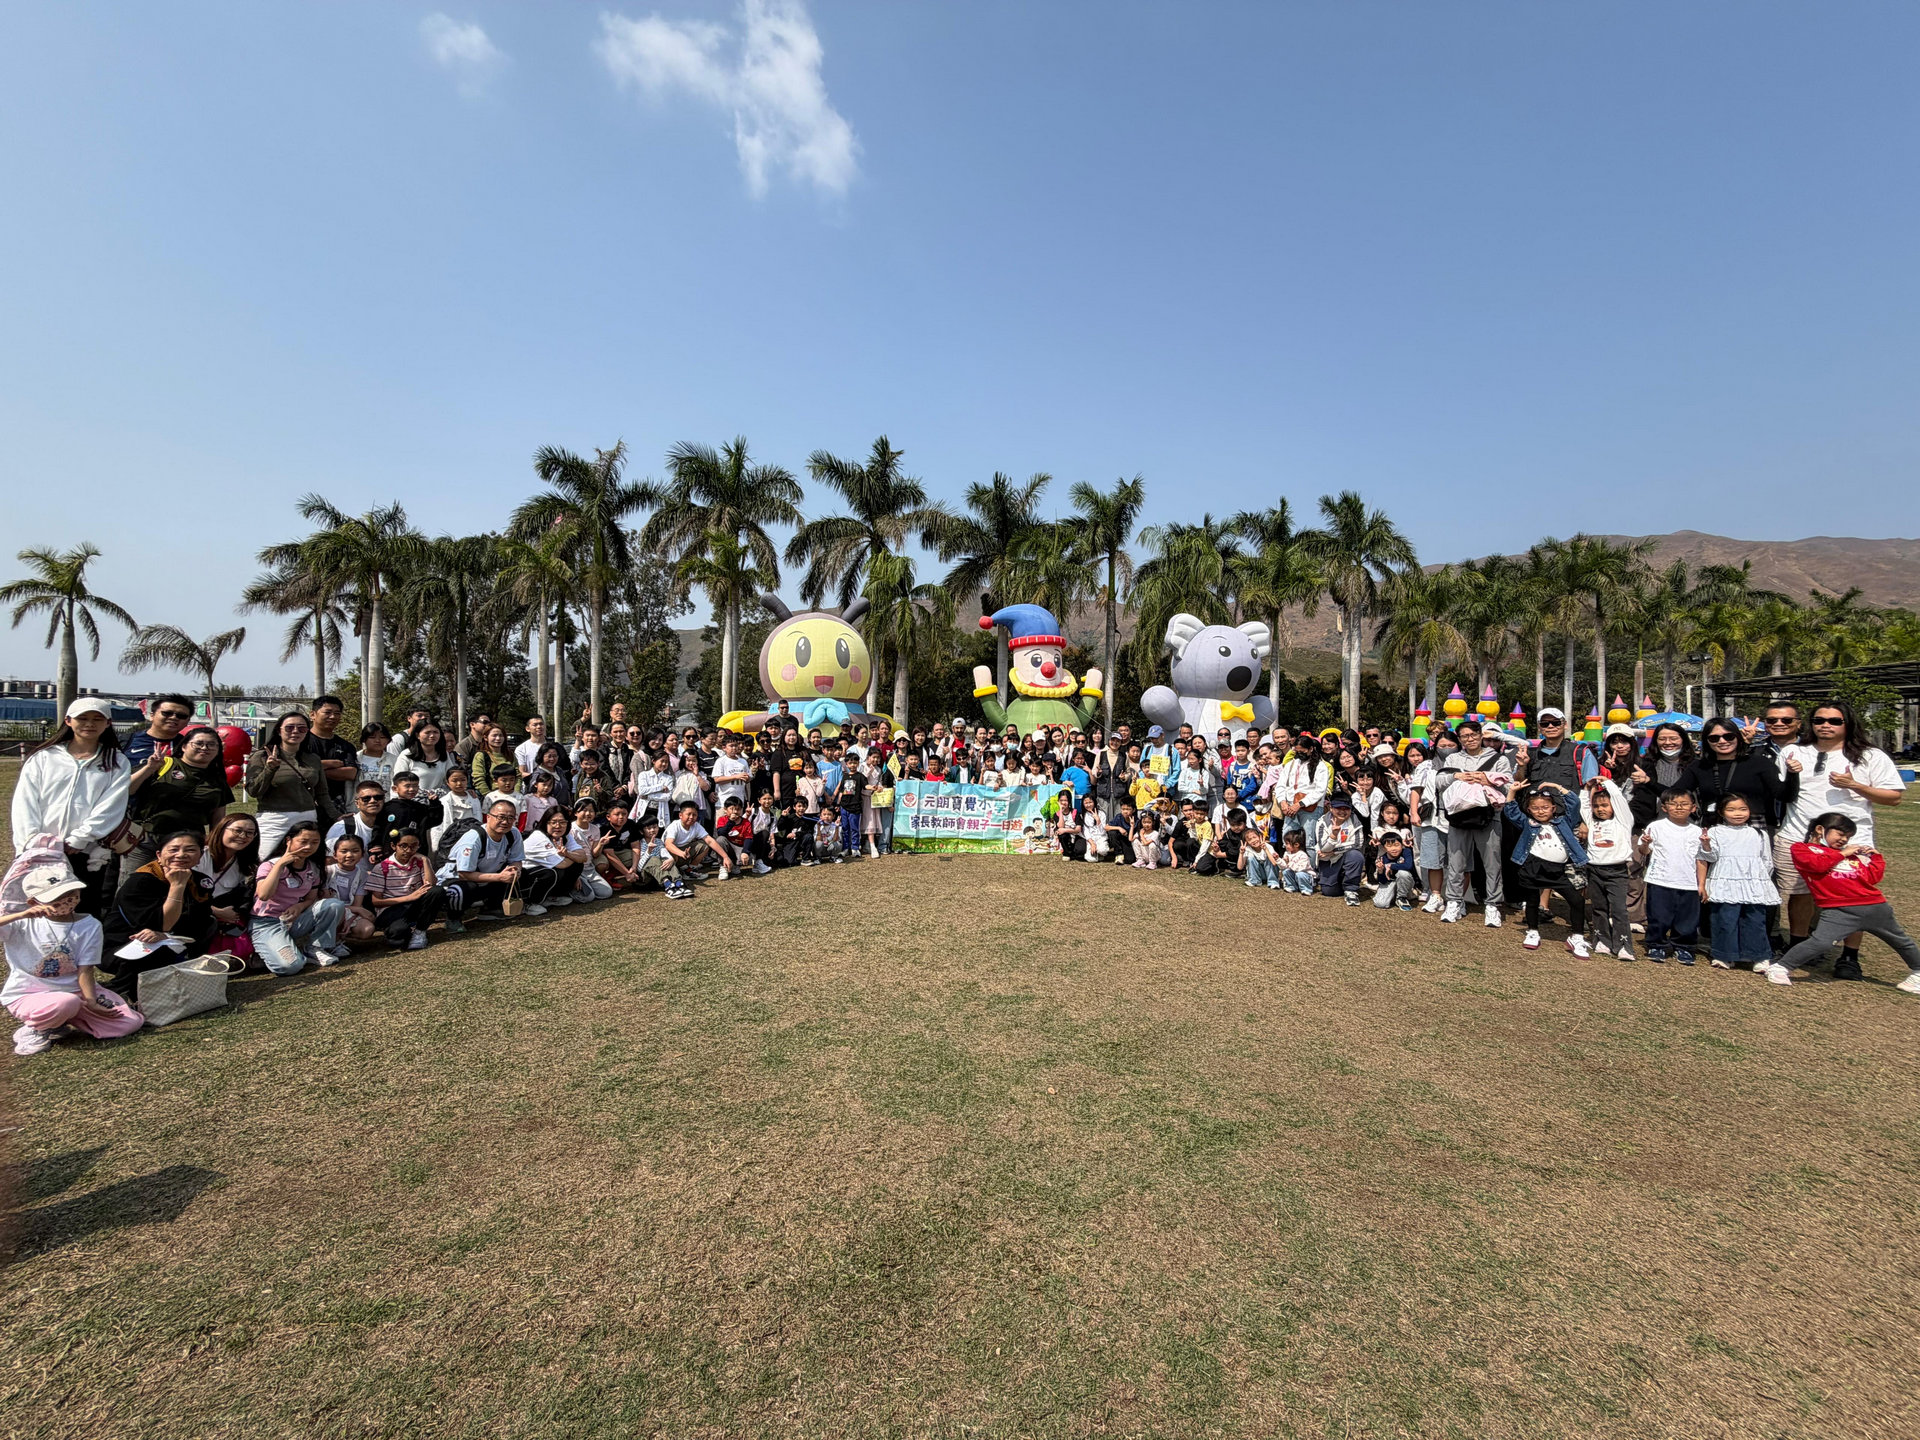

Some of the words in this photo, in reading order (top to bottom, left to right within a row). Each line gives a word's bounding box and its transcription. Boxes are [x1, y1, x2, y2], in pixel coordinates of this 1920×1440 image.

[910, 815, 1023, 831] 家長教師會親子一日遊
